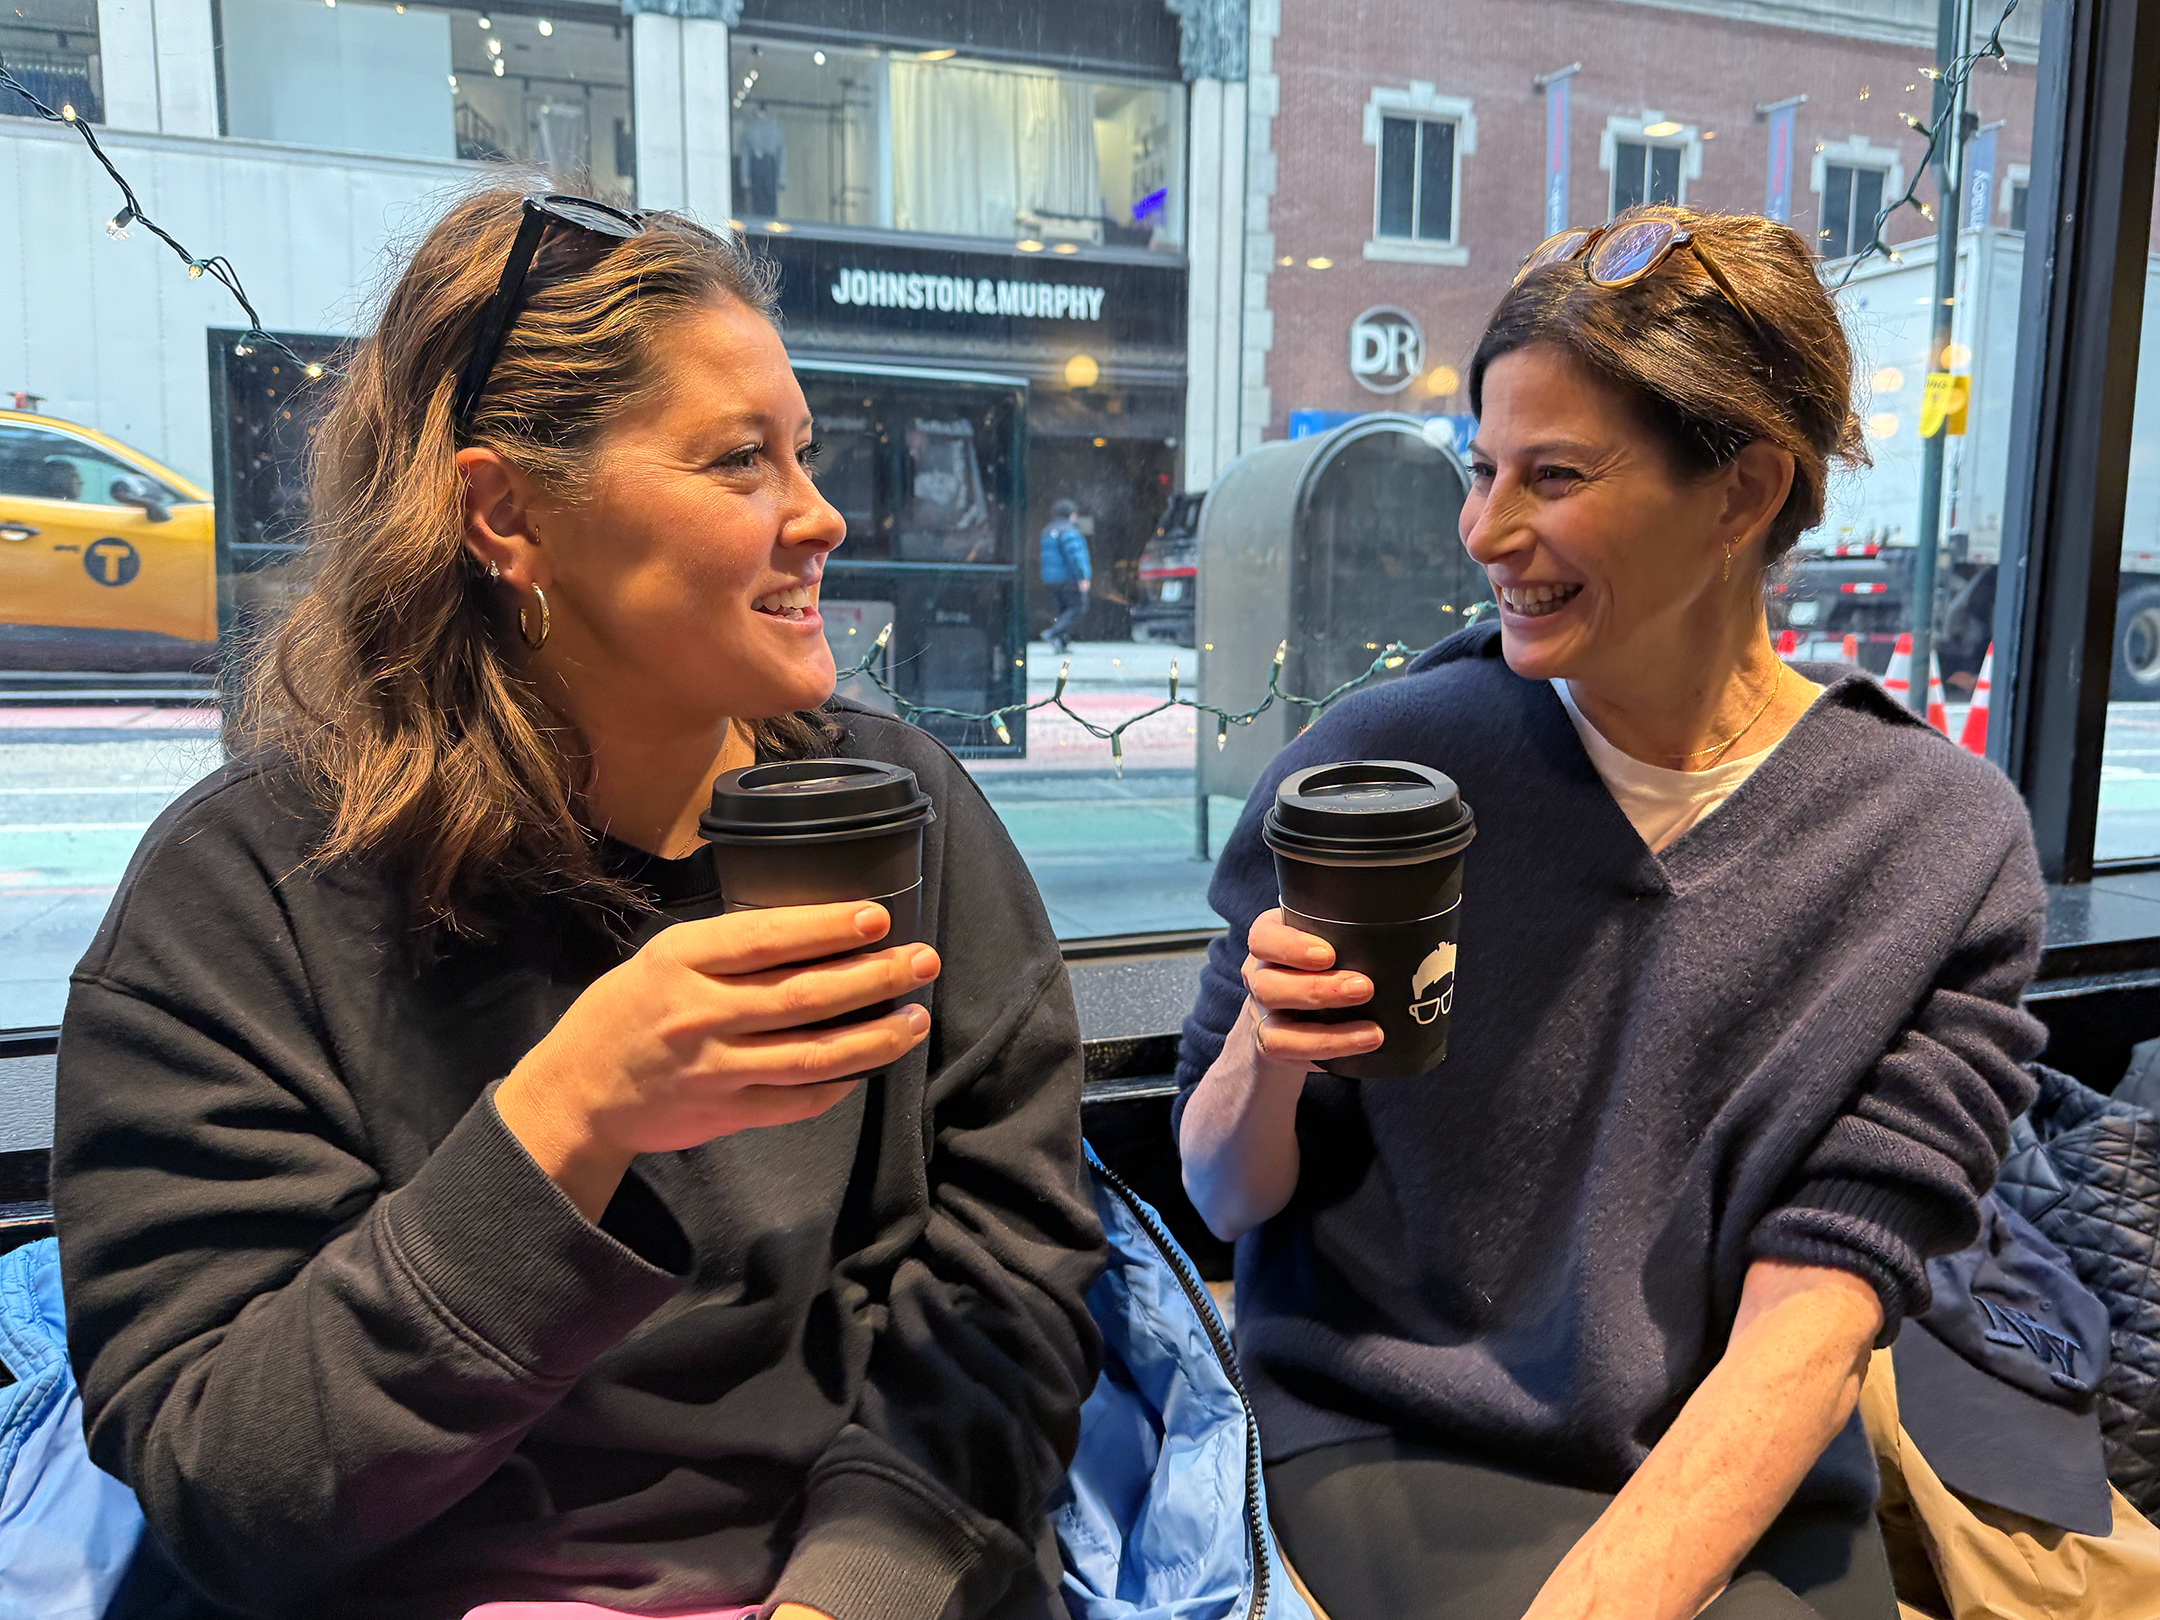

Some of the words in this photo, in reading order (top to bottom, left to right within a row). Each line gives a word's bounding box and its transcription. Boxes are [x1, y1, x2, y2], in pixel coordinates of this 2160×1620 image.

[1970, 169, 1989, 228] macy
[831, 267, 1105, 322] JOHNSTON&MURPHY
[1350, 322, 1420, 376] DR
[94, 544, 130, 582] T
